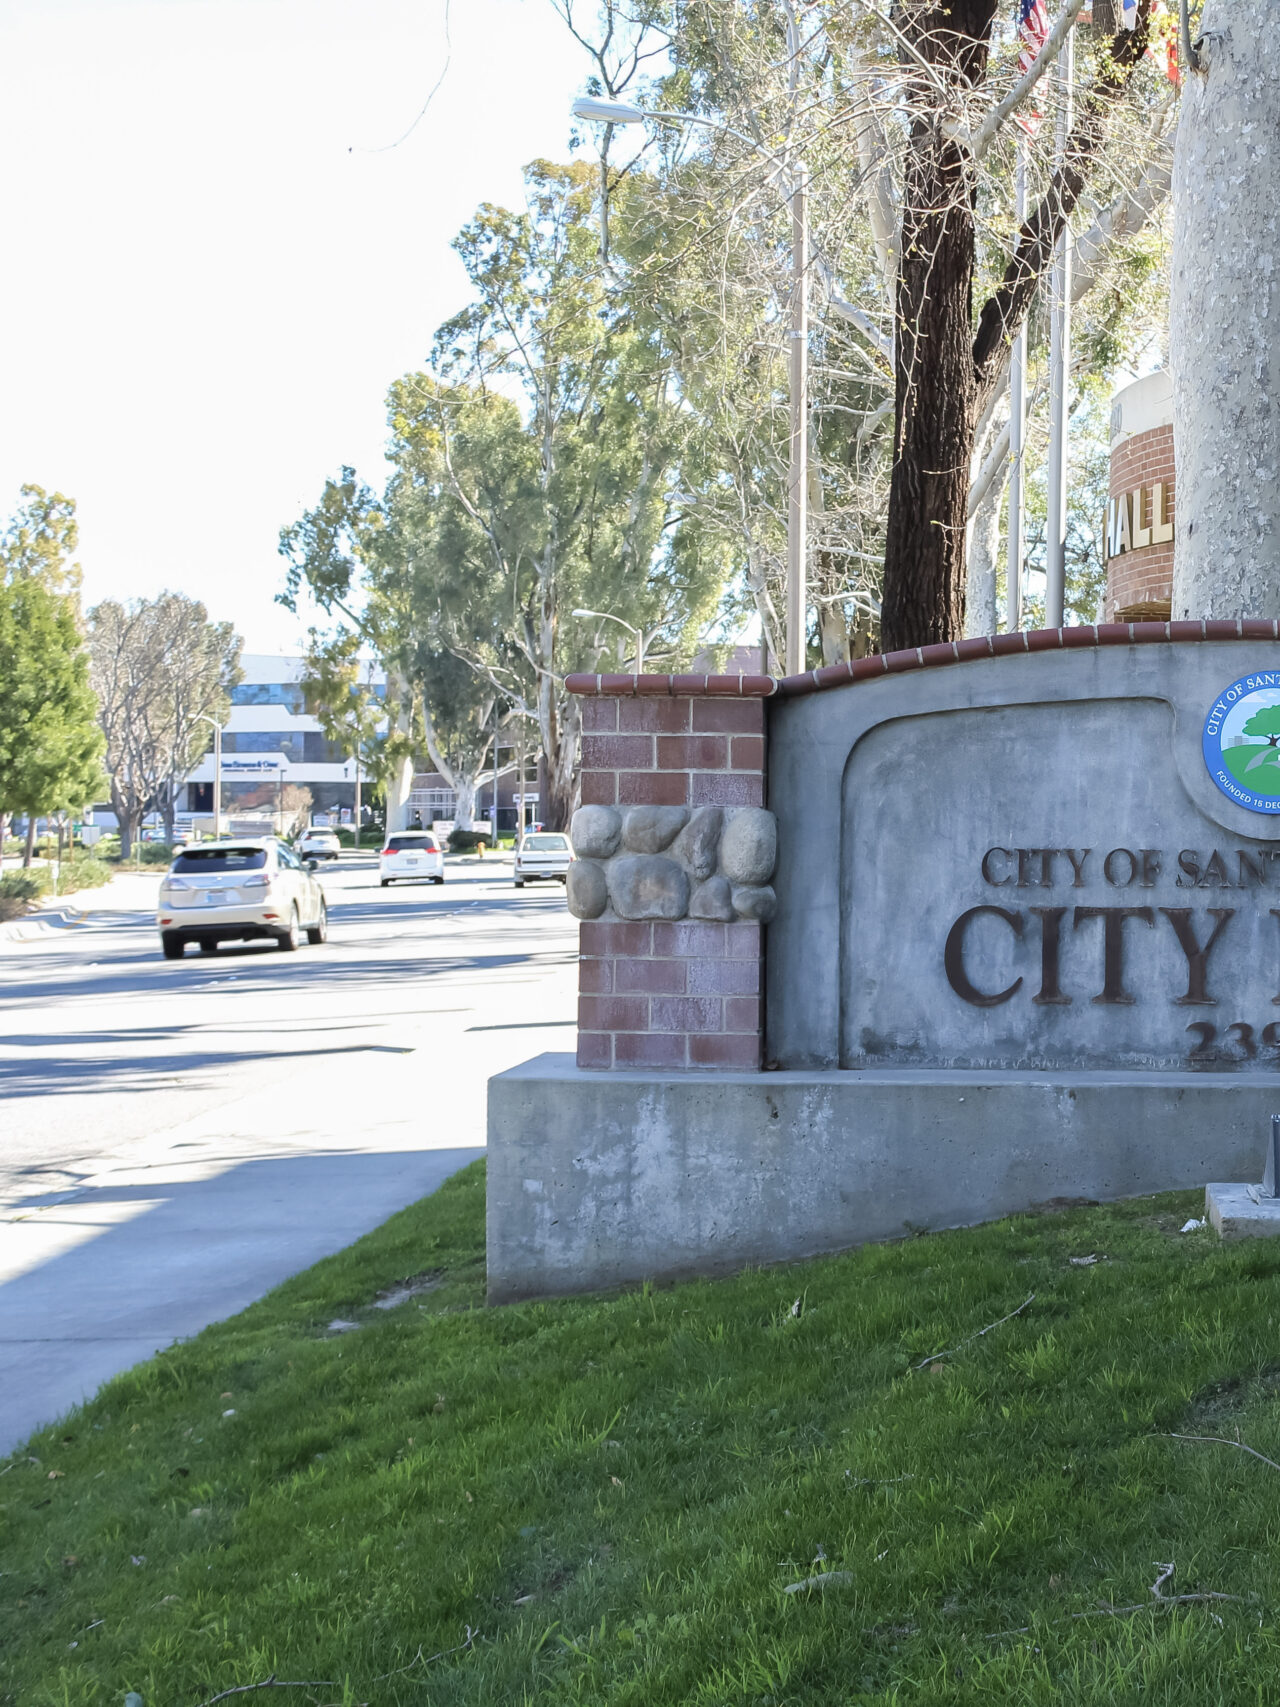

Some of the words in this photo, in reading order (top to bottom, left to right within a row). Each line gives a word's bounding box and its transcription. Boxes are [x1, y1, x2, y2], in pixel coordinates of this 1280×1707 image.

[1103, 482, 1174, 560] HALL
[1207, 700, 1228, 736] CITY
[1226, 683, 1244, 701] OF
[1216, 770, 1252, 803] FOUNDED
[1253, 799, 1263, 808] 15
[981, 847, 1092, 888] CITY
[1103, 848, 1163, 888] OF
[944, 904, 1235, 1008] CITY
